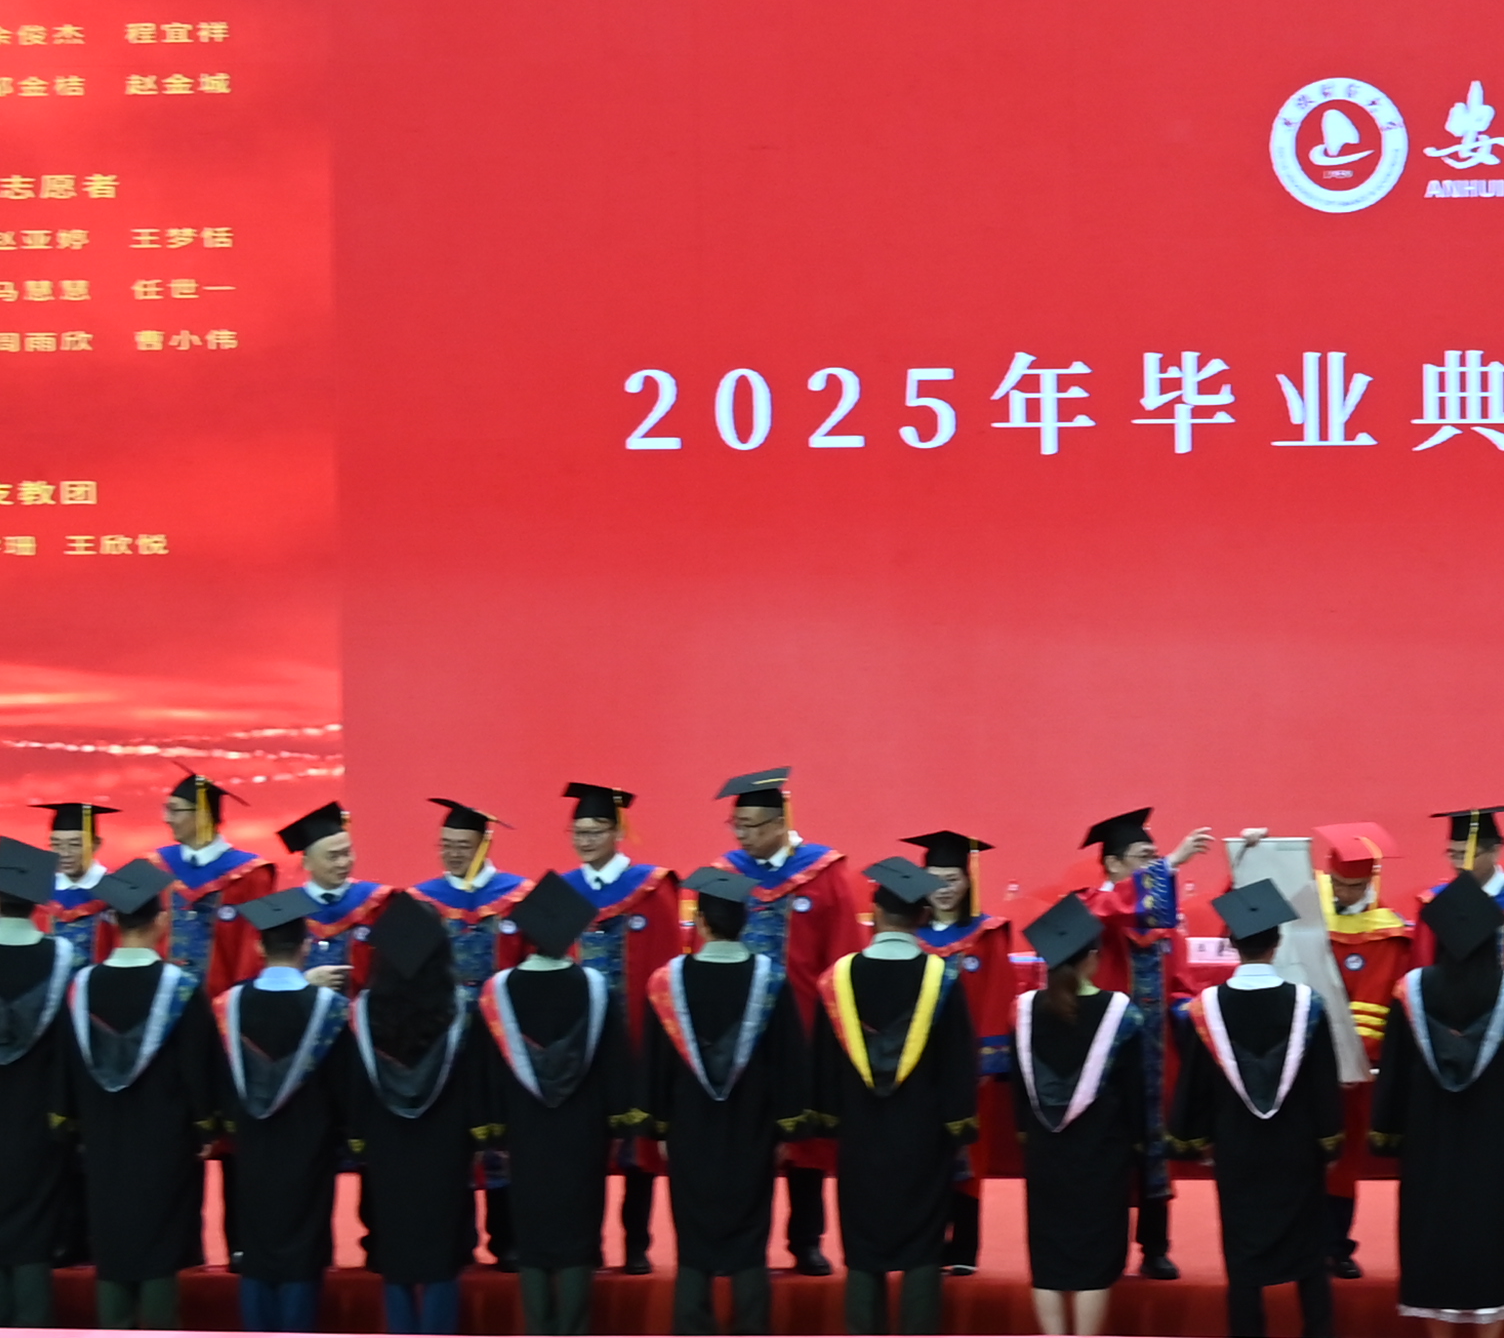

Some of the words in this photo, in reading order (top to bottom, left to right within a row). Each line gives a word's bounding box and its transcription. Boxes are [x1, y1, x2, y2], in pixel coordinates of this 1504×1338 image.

[125, 21, 229, 44] 程宜祥
[125, 72, 231, 95] 赵金城
[1424, 179, 1504, 199] ANHUI
[131, 278, 236, 300] 任世一
[134, 329, 238, 351] 曹小伟
[63, 534, 169, 555] 王欣悦
